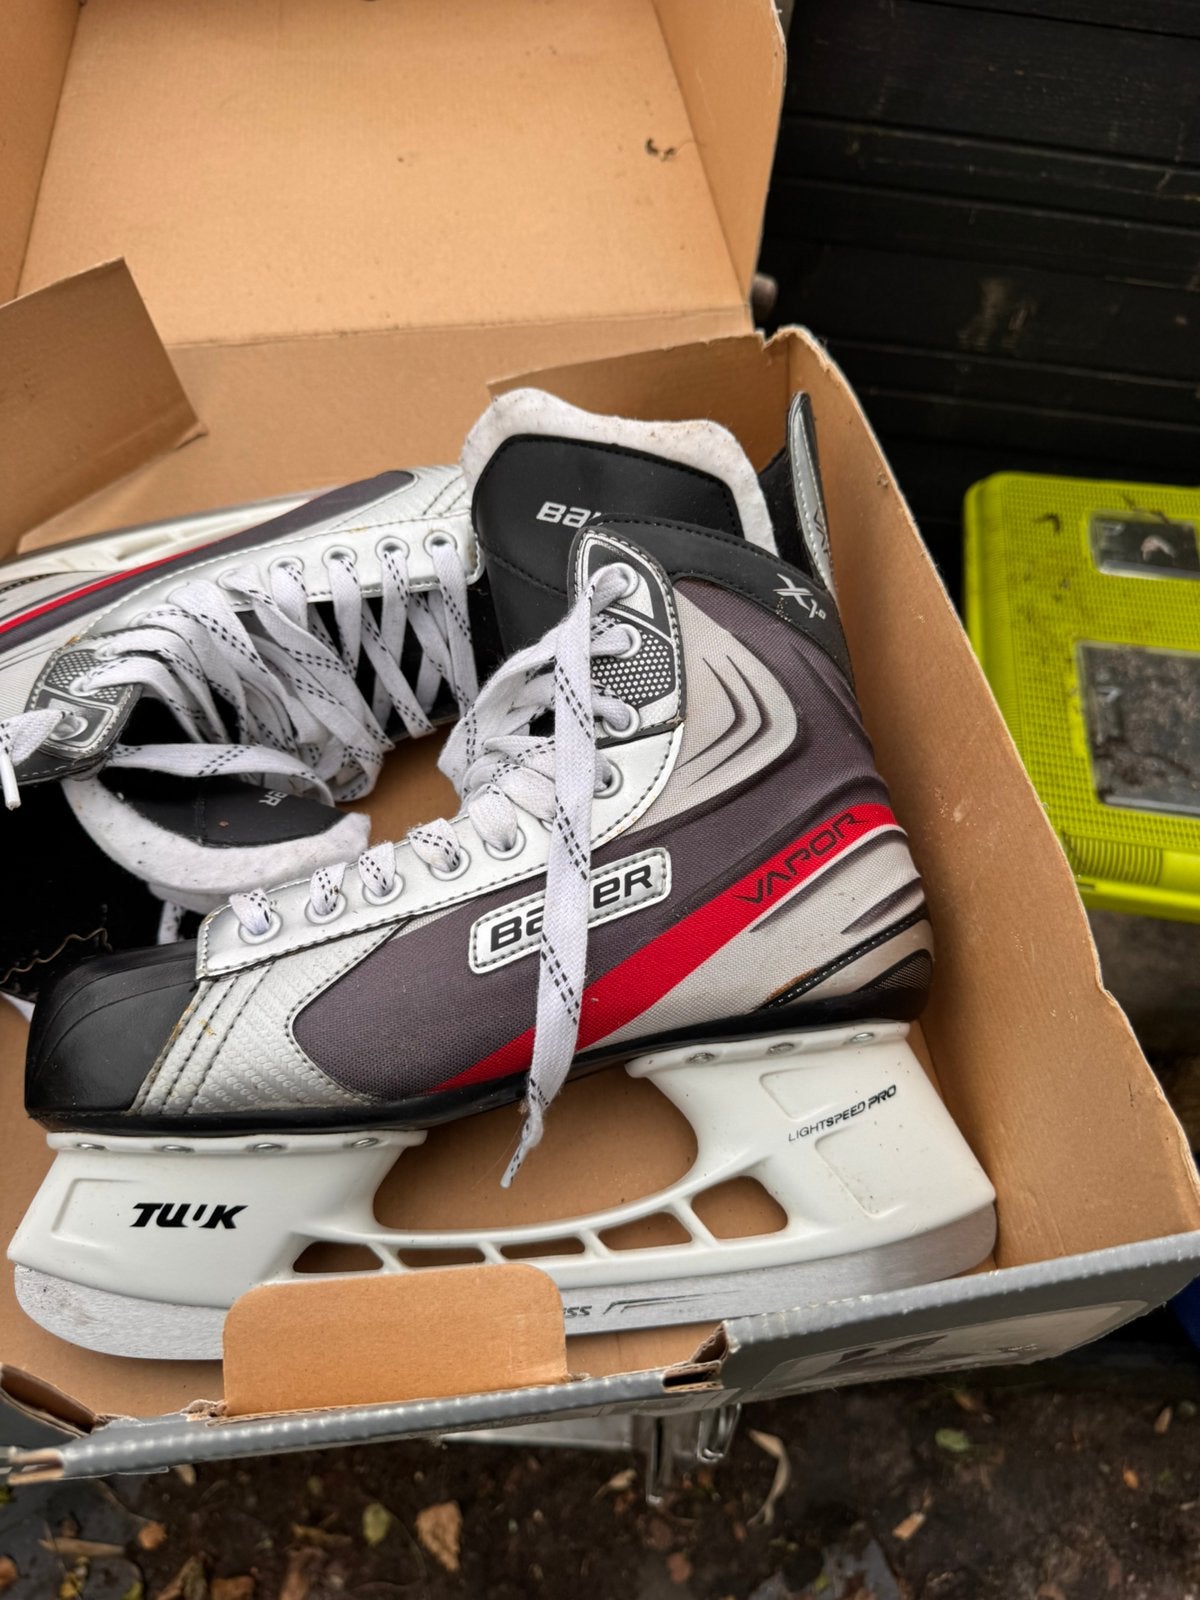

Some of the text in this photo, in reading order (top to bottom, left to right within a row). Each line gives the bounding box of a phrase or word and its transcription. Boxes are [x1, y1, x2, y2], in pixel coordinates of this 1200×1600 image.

[734, 812, 868, 904] VAPOR
[788, 1084, 897, 1142] LIGHTSPEED PRO
